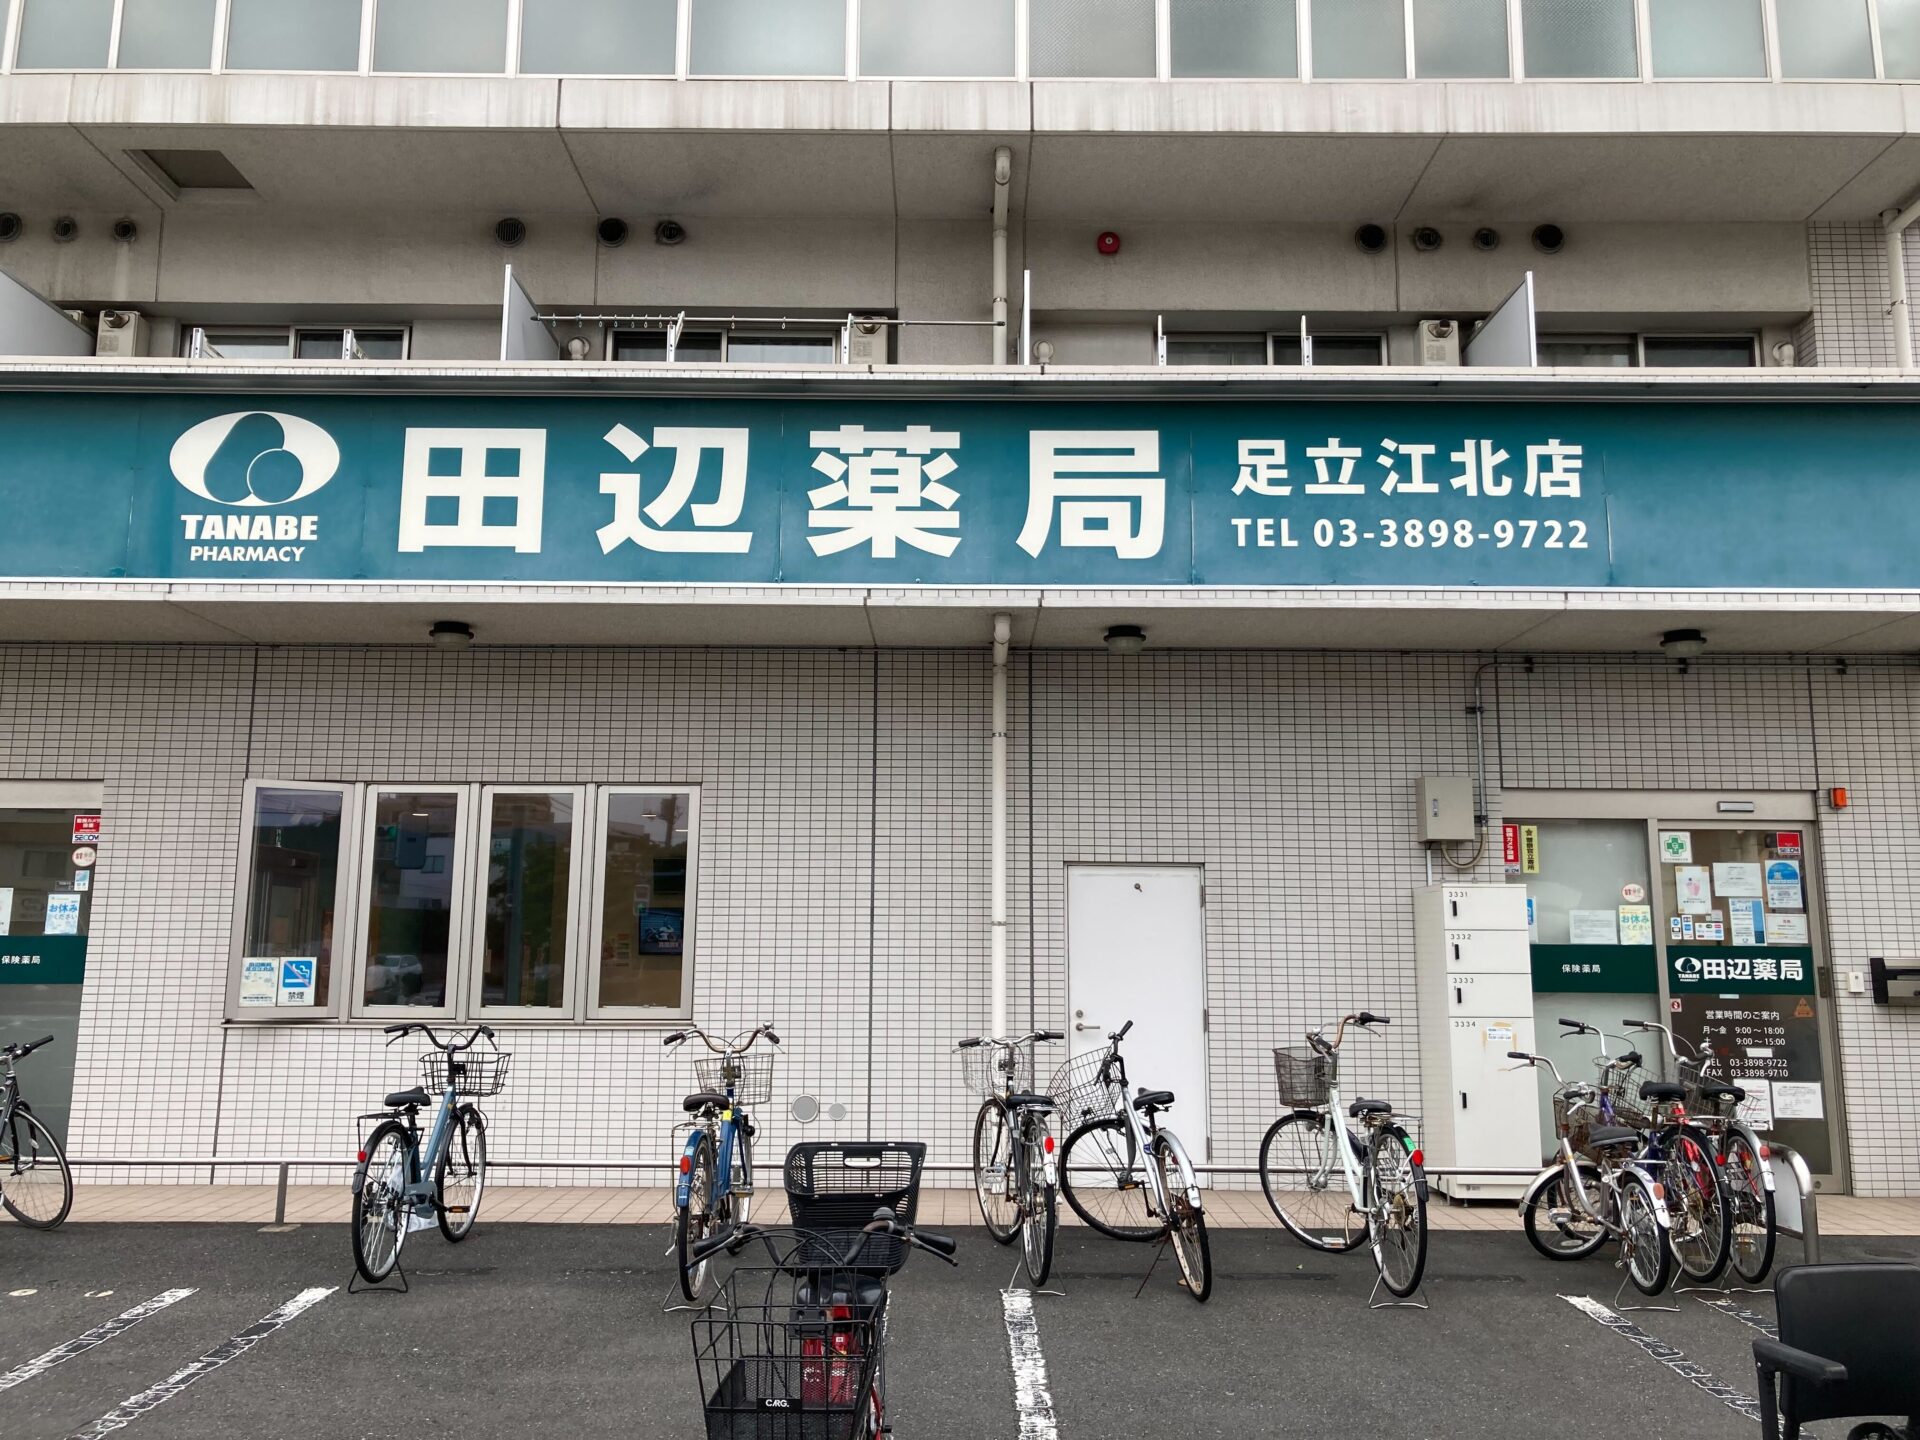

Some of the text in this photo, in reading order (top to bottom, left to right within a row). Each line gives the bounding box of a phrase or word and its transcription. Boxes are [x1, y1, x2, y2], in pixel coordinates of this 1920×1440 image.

[1231, 438, 1582, 498] 足立江北店
[397, 422, 1166, 560] 田辺薬局
[180, 514, 319, 541] TANABE
[1231, 518, 1588, 549] TEL 03-3898-9722
[189, 546, 306, 562] PHARMACY
[1, 955, 41, 965] 保険薬局
[1561, 964, 1601, 974] 保険薬局
[1702, 958, 1804, 981] 田辺薬局
[1705, 1010, 1780, 1021] 営業時間のご案内
[1735, 1027, 1752, 1035] 9:00
[1763, 1027, 1785, 1035] 18:00
[1736, 1038, 1753, 1046] 9:00
[1764, 1038, 1786, 1046] 15:00
[1729, 1059, 1788, 1067] 03-3898-9722
[1706, 1068, 1789, 1078] FAX 03-3898-9710
